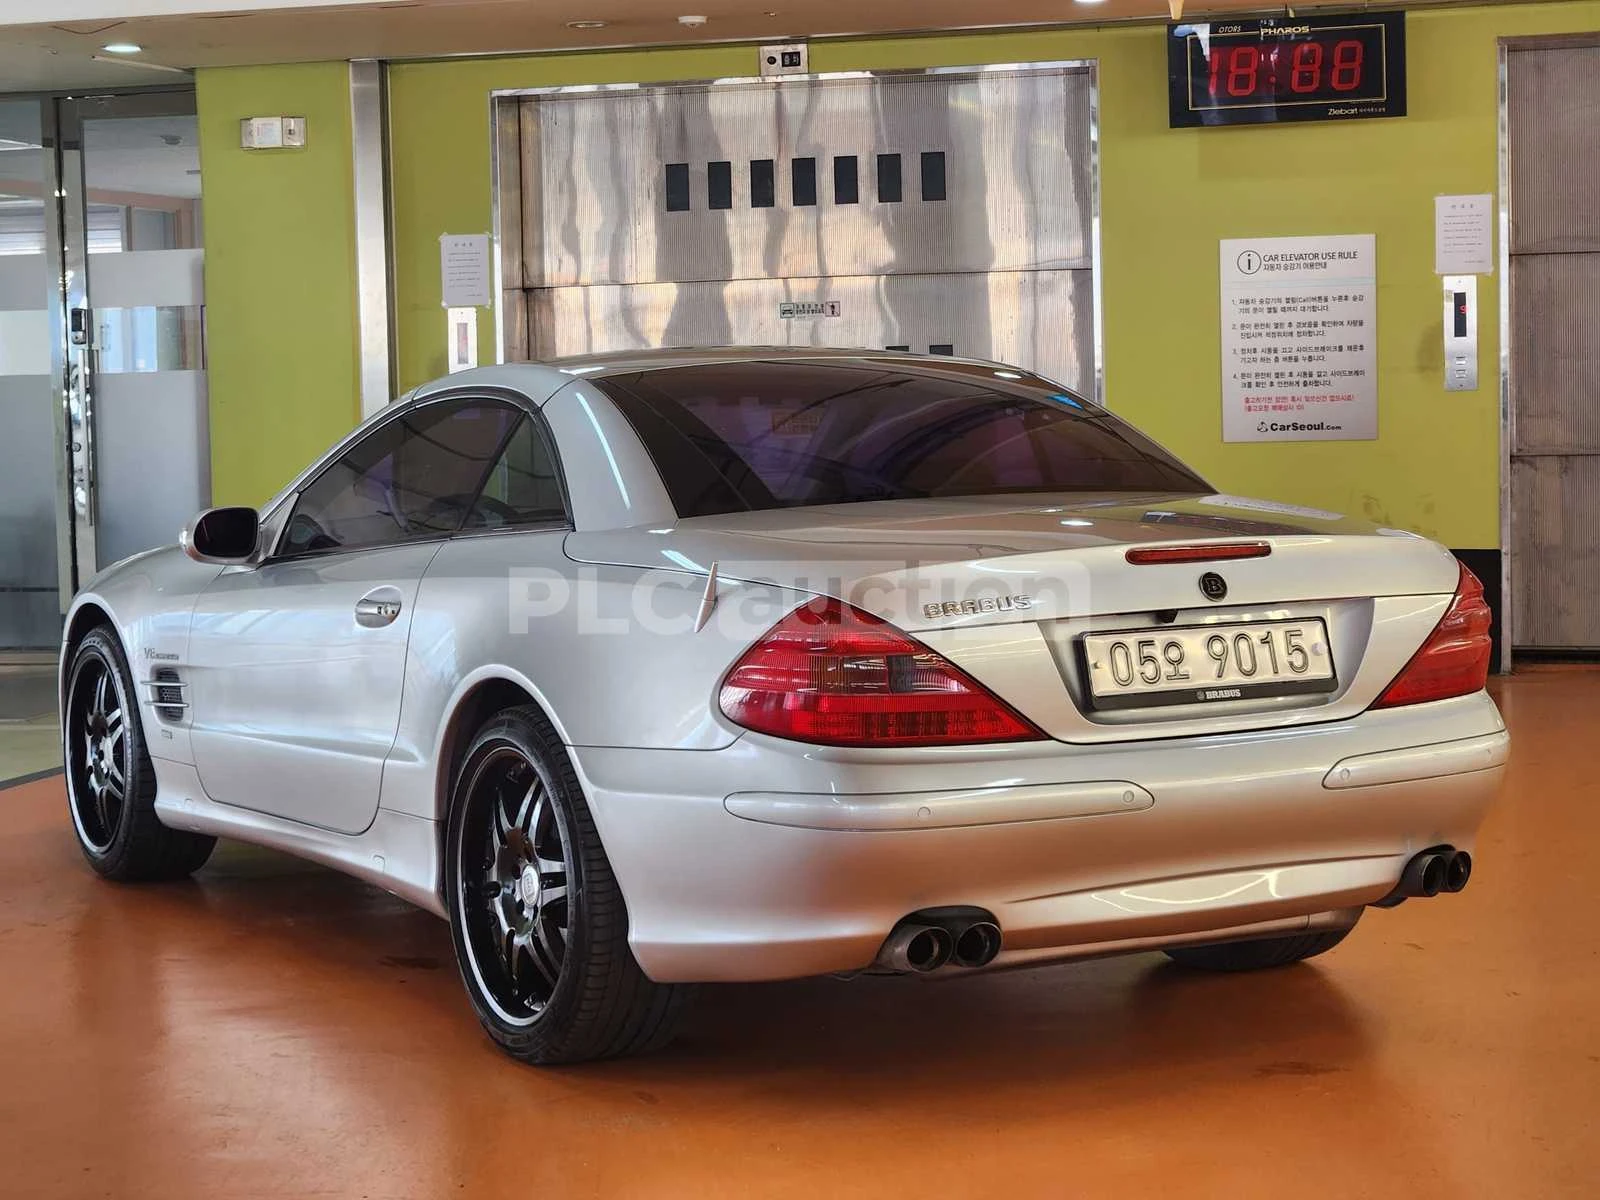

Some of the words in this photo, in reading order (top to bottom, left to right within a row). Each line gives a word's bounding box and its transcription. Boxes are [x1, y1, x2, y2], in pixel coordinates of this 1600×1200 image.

[1261, 26, 1310, 34] PHAROS
[1281, 253, 1319, 261] ELEVATOR
[1338, 251, 1358, 259] RULE
[924, 594, 1032, 618] BRABUS
[1110, 640, 1190, 686] 05오
[1207, 629, 1309, 678] 9015
[1206, 688, 1241, 698] BRABUS
